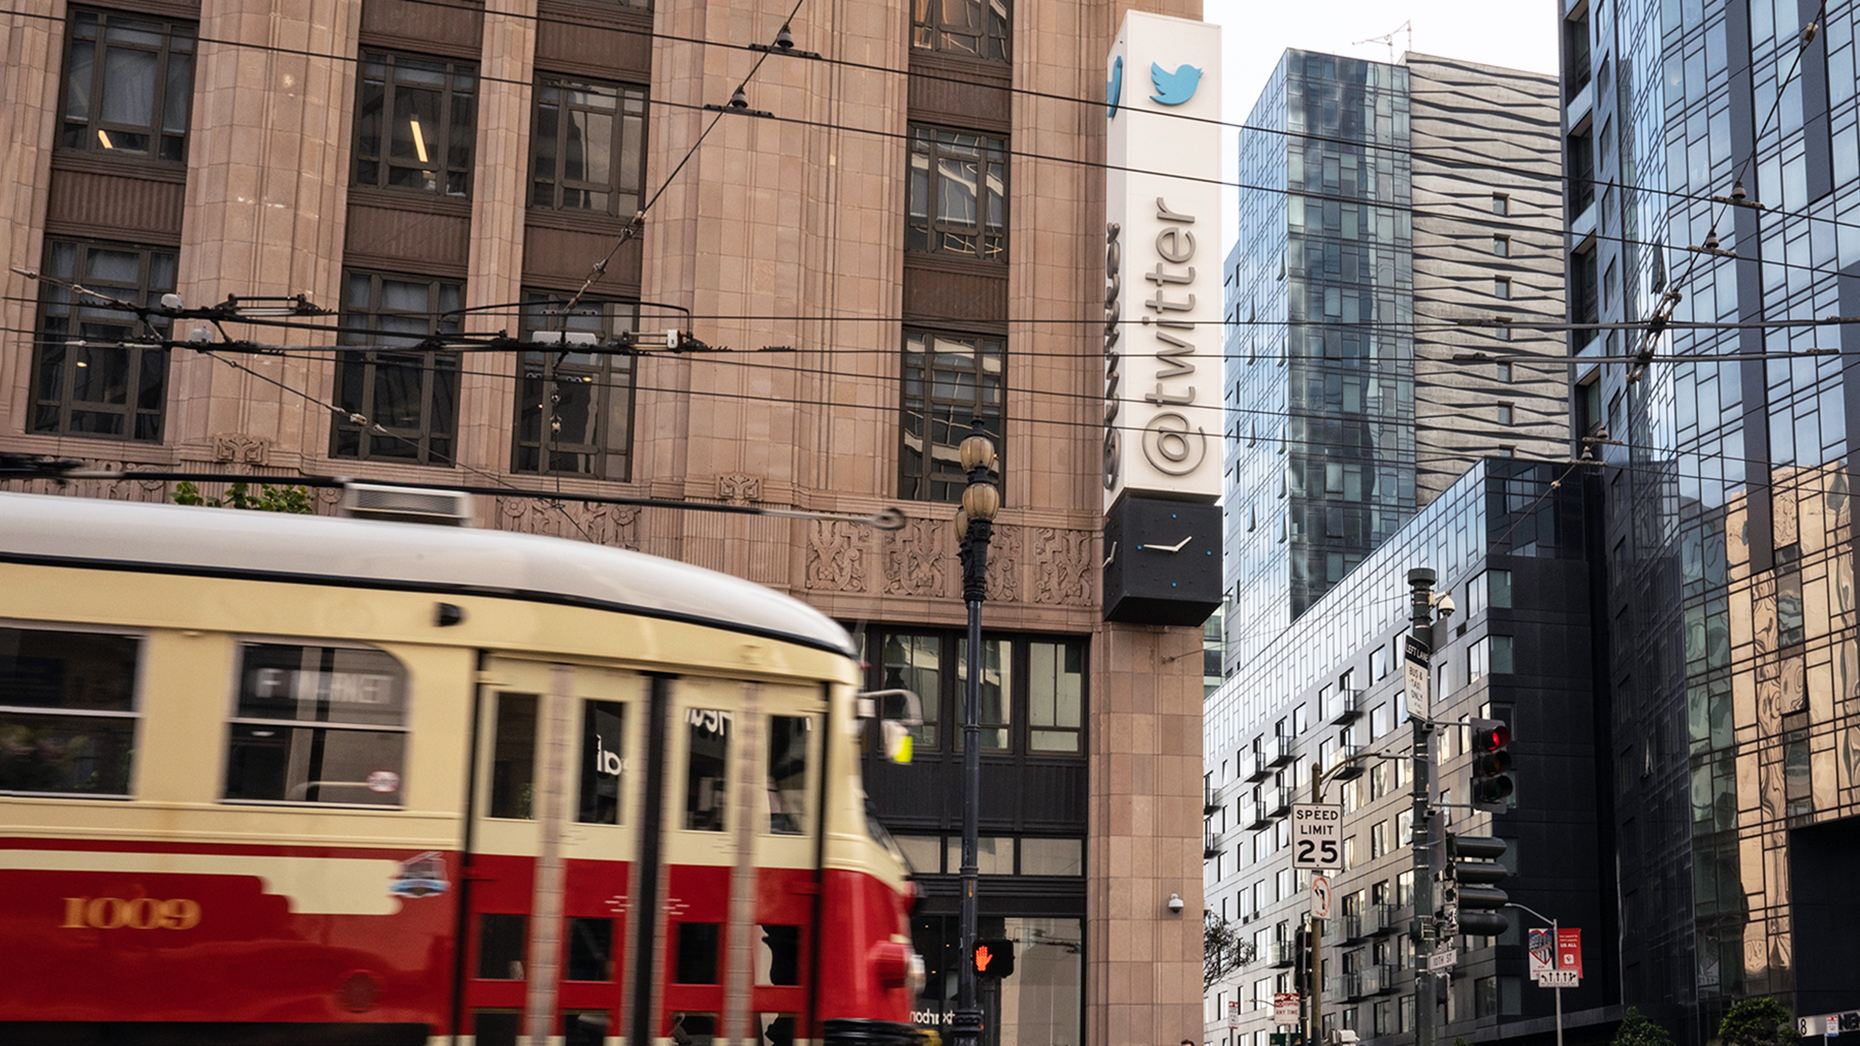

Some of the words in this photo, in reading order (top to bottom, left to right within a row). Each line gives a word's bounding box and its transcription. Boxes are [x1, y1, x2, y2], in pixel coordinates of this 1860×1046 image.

[1142, 197, 1207, 476] @twitter
[1406, 644, 1416, 657] LEFT
[1417, 649, 1429, 663] LANE
[1409, 666, 1418, 678] BUS
[1296, 809, 1339, 820] SPEED
[1301, 825, 1334, 835] LIMIT
[1297, 840, 1338, 863] 25
[56, 897, 203, 930] 1009
[1446, 952, 1452, 963] ST
[1800, 1018, 1807, 1035] 8
[1838, 1011, 1860, 1031] NE
